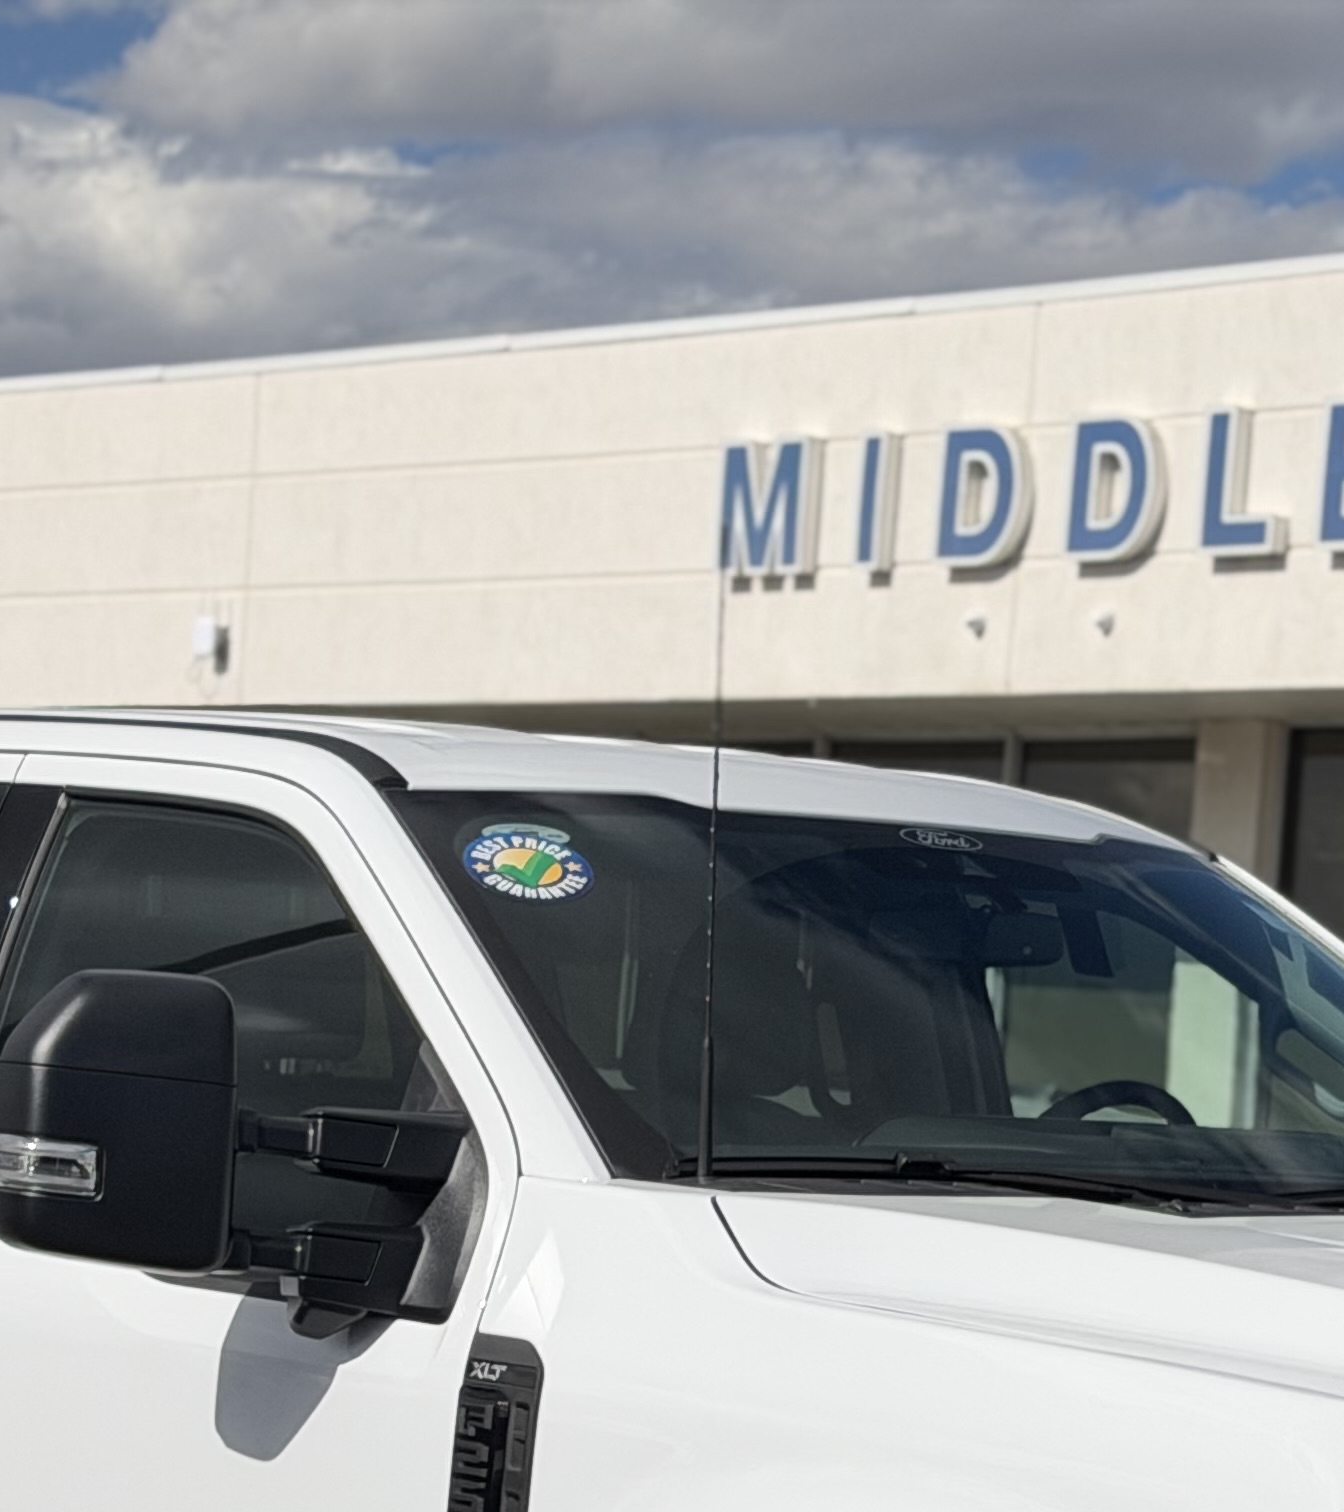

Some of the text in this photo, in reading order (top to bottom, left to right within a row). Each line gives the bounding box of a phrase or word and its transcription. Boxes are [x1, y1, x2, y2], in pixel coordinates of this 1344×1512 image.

[471, 835, 572, 861] BEST PRICE
[483, 873, 588, 900] GUARANTEE
[470, 1361, 508, 1381] XLT
